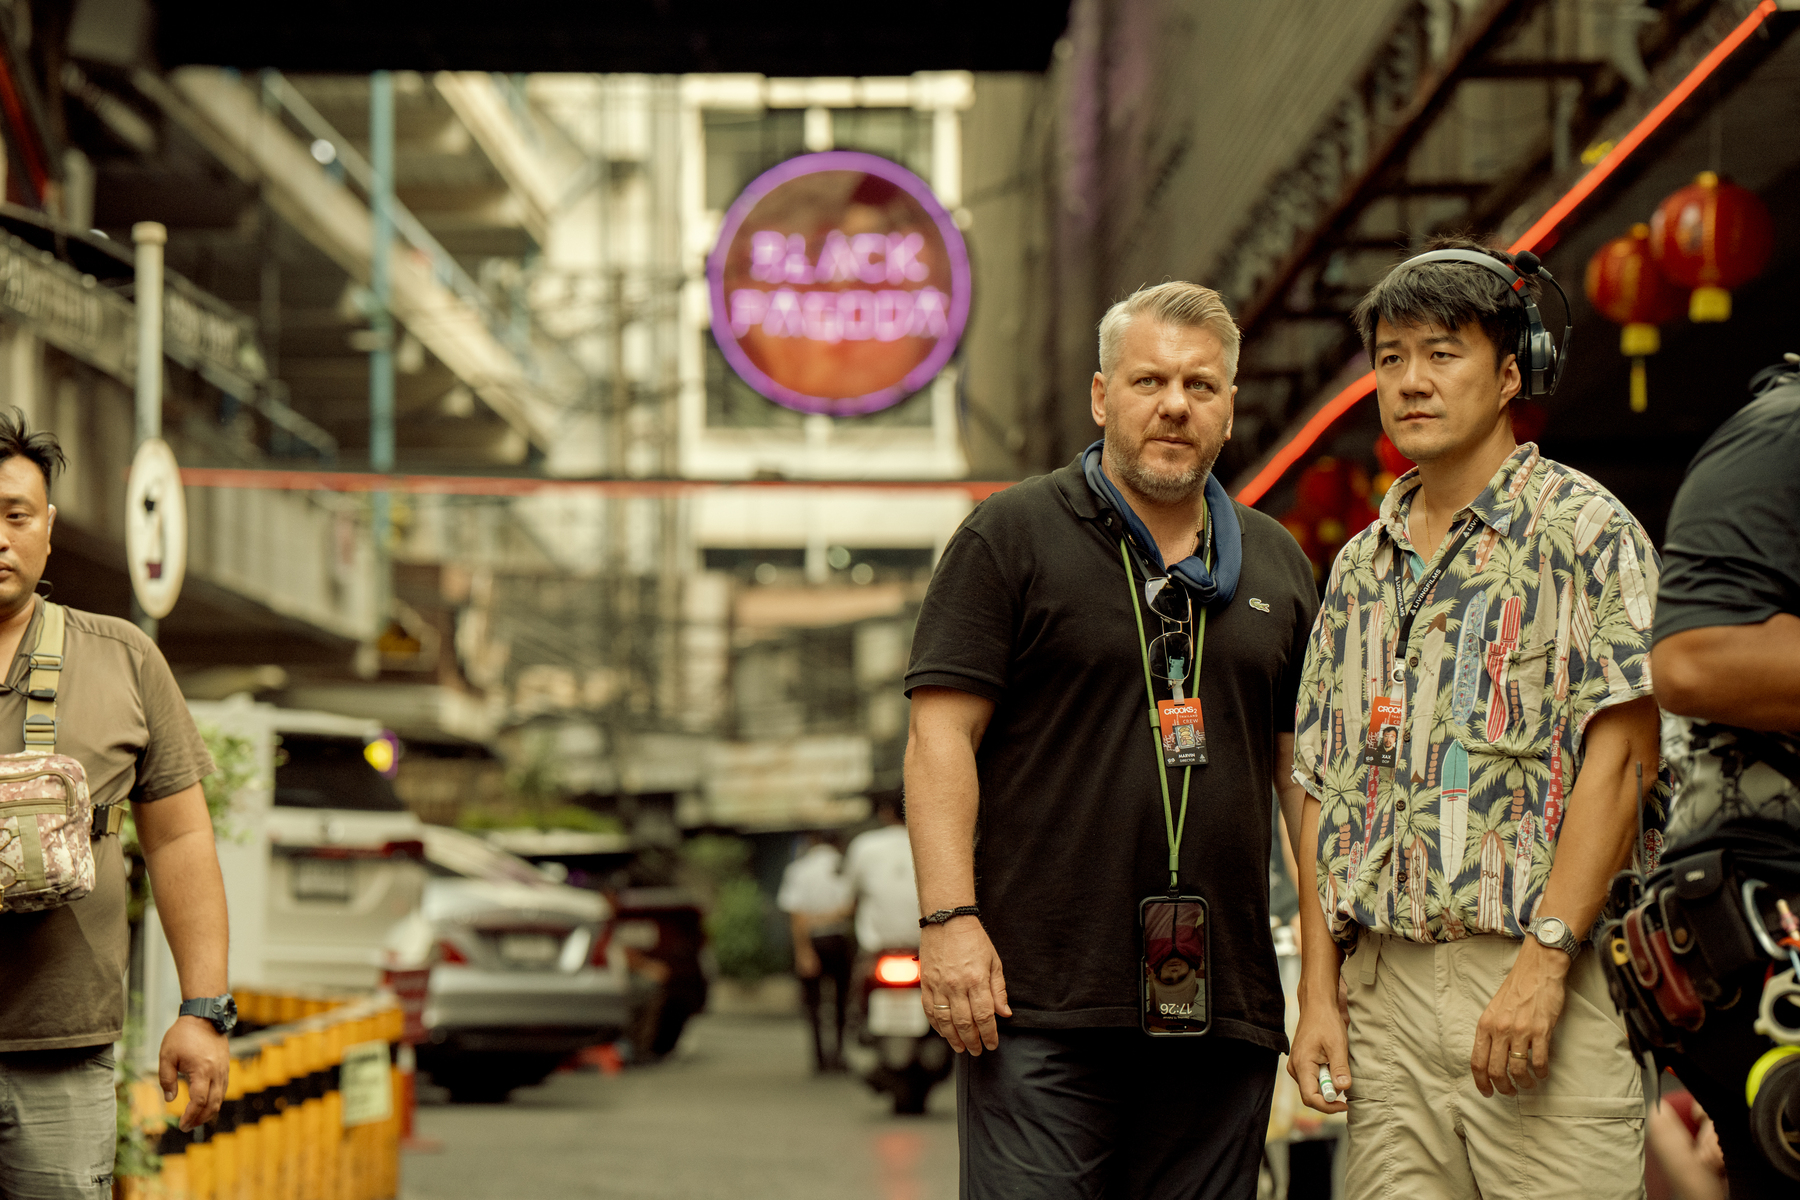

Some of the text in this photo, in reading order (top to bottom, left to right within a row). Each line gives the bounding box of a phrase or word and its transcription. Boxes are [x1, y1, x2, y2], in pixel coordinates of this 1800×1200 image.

[750, 229, 930, 285] BLACK
[730, 286, 950, 344] PAGODA
[1413, 568, 1442, 609] LIVINGFILMS
[1163, 706, 1194, 716] CROOKS
[1377, 705, 1402, 714] CROOK
[1482, 870, 1500, 880] PUA
[1160, 1003, 1193, 1015] 17:26
